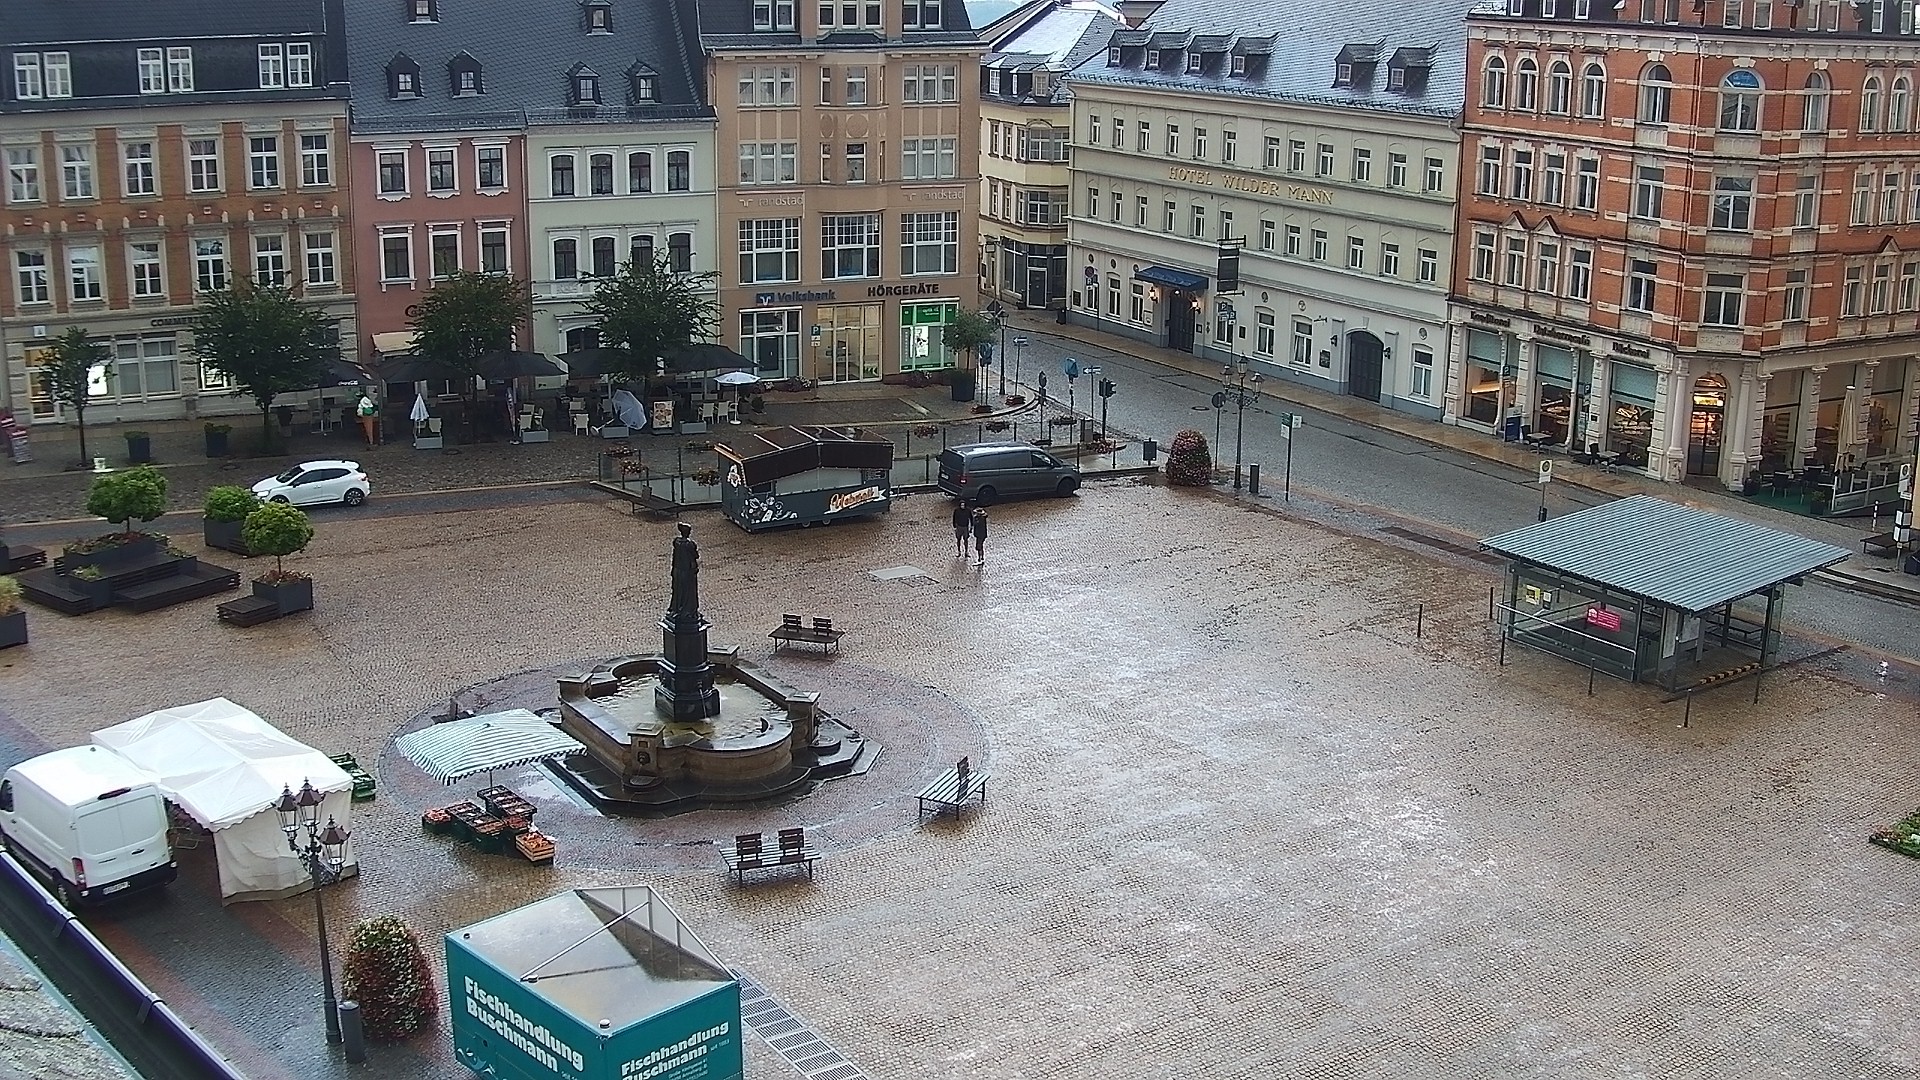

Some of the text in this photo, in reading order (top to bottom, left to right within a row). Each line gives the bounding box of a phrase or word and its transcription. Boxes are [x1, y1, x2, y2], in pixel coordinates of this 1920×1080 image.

[1169, 166, 1334, 206] HOTEL WILDER MANN
[758, 194, 804, 207] randstad
[777, 289, 836, 303] Volksbank
[867, 282, 940, 297] HÖRGERÄTE
[1470, 311, 1511, 328] Konditorei
[1612, 341, 1650, 359] Bäckerei
[464, 975, 584, 1072] Fischhandlung
[466, 995, 558, 1073] Buschmann
[621, 1021, 730, 1077] Fischhandlung
